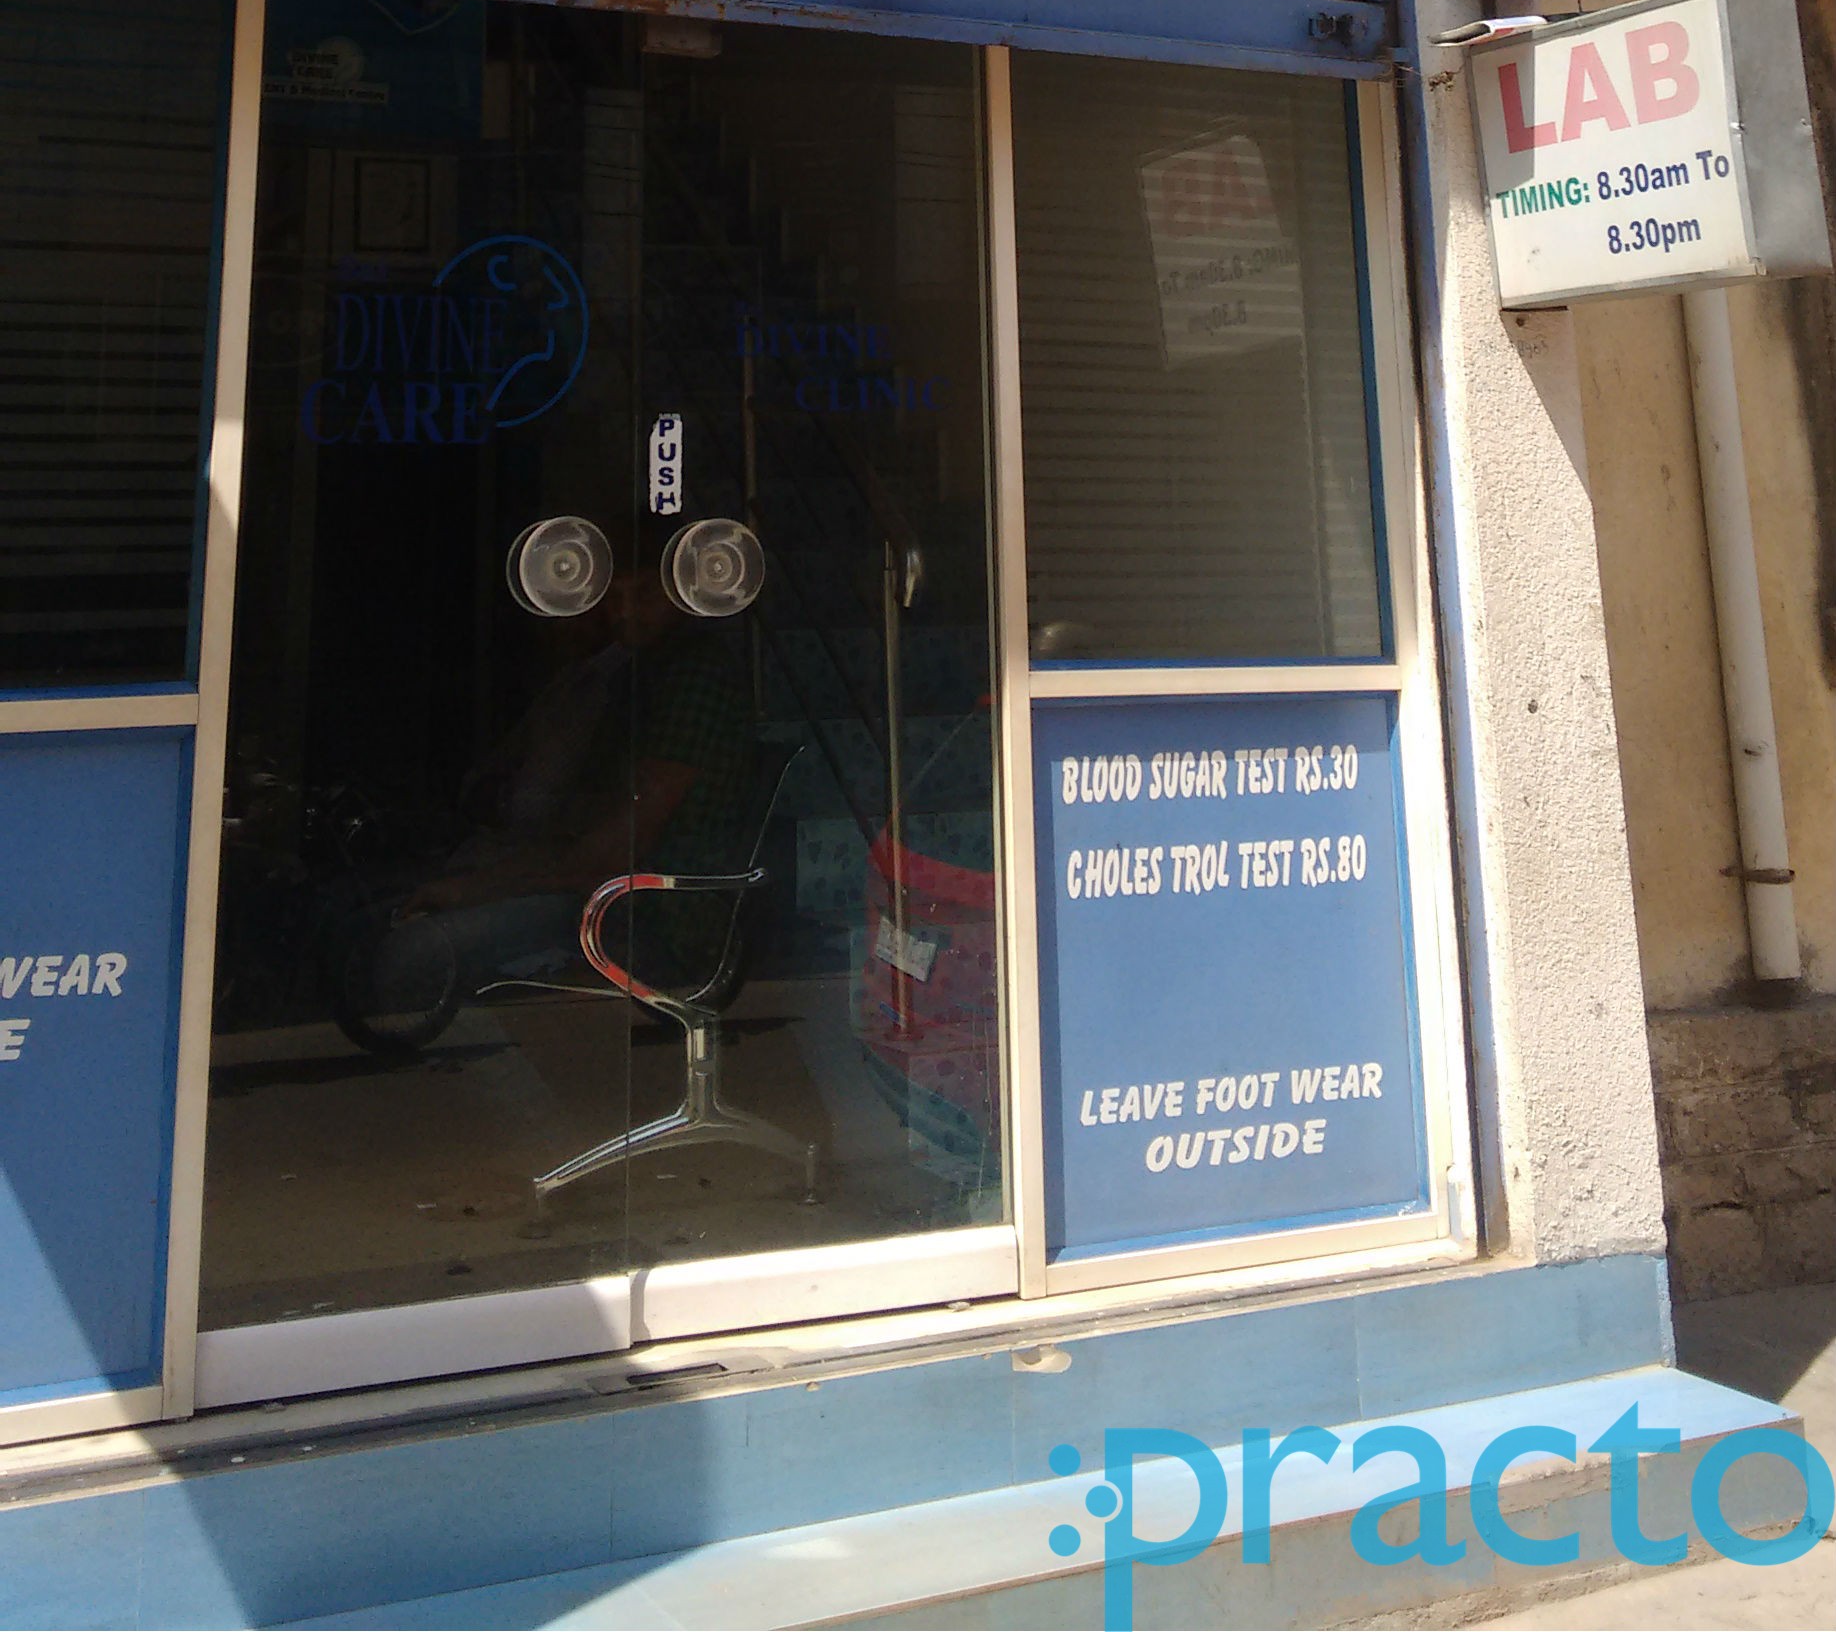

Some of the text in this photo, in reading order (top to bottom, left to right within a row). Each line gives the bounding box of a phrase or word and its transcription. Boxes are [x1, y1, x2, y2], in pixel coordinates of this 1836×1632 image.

[1497, 21, 1701, 154] LAB
[1496, 149, 1730, 219] TIMING: 8.30am To
[1606, 217, 1702, 255] 8.30pm
[335, 291, 509, 374] DIVINE
[734, 321, 894, 360] DIVINE
[300, 378, 492, 446] CARE
[793, 374, 953, 414] CLINIC
[657, 418, 677, 511] PUSH
[1062, 744, 1359, 805] BLOOD SUGAR TEST RS.30
[1066, 834, 1367, 900] CHOLES TROL TEST RS.80
[1080, 1062, 1383, 1127] LEAVE FOOT WEAR
[1145, 1118, 1328, 1174] OUTSIDE
